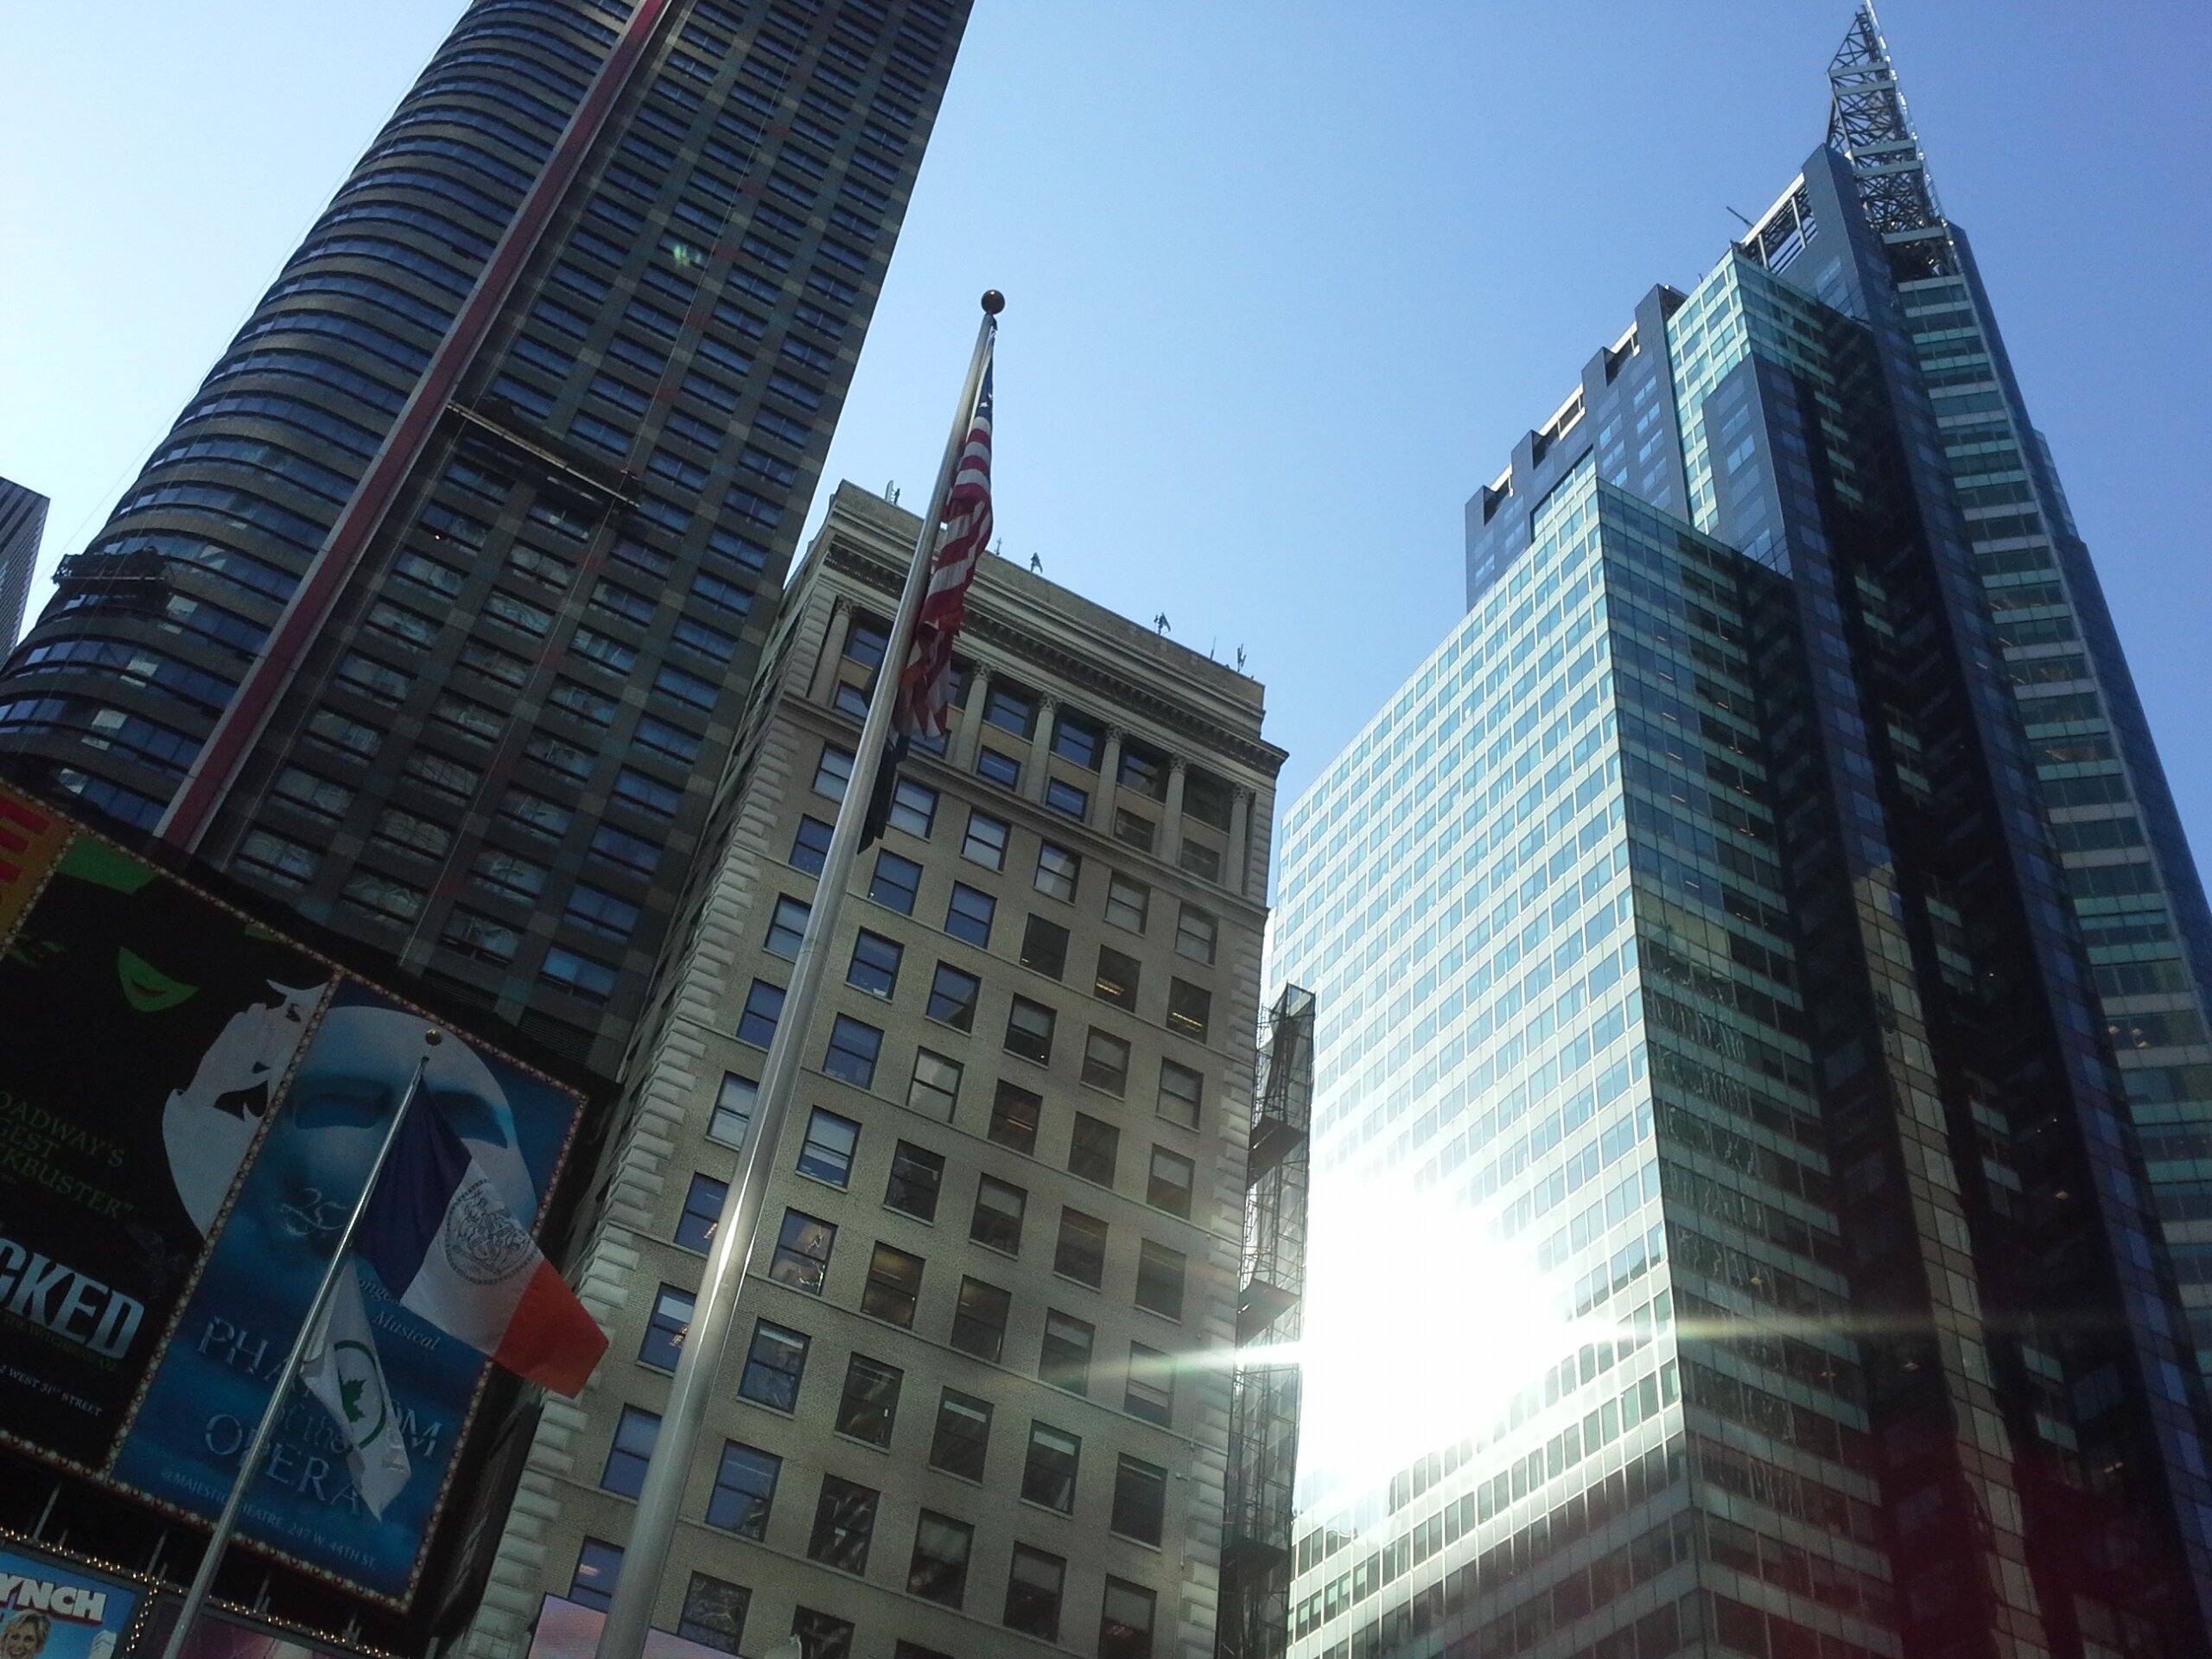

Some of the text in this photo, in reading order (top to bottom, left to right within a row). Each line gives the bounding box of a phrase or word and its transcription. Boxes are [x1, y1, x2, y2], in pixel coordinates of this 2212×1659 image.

[372, 1311, 442, 1351] Musical
[10, 1366, 41, 1389] WEST
[60, 1391, 104, 1417] STREET
